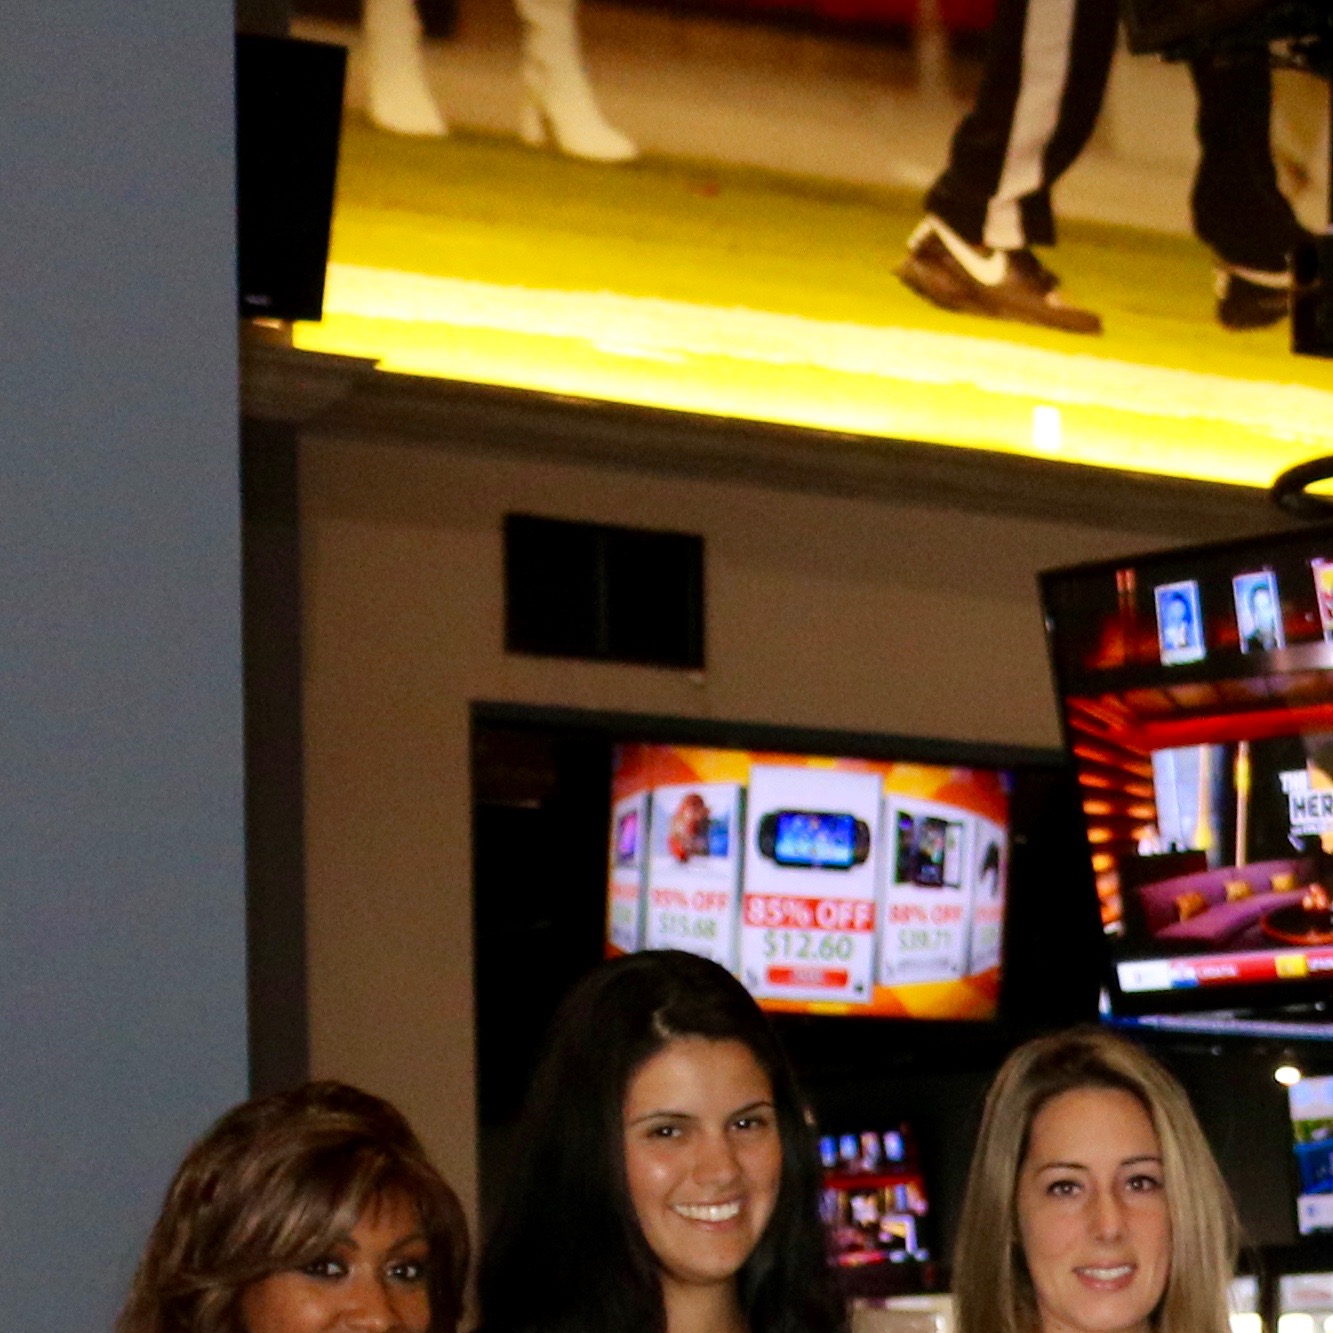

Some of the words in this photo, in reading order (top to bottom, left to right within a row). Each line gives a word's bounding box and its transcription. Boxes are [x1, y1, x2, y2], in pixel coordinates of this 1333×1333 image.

[745, 896, 810, 930] 85%
[814, 900, 873, 931] OFF
[763, 930, 854, 962] $12.60
